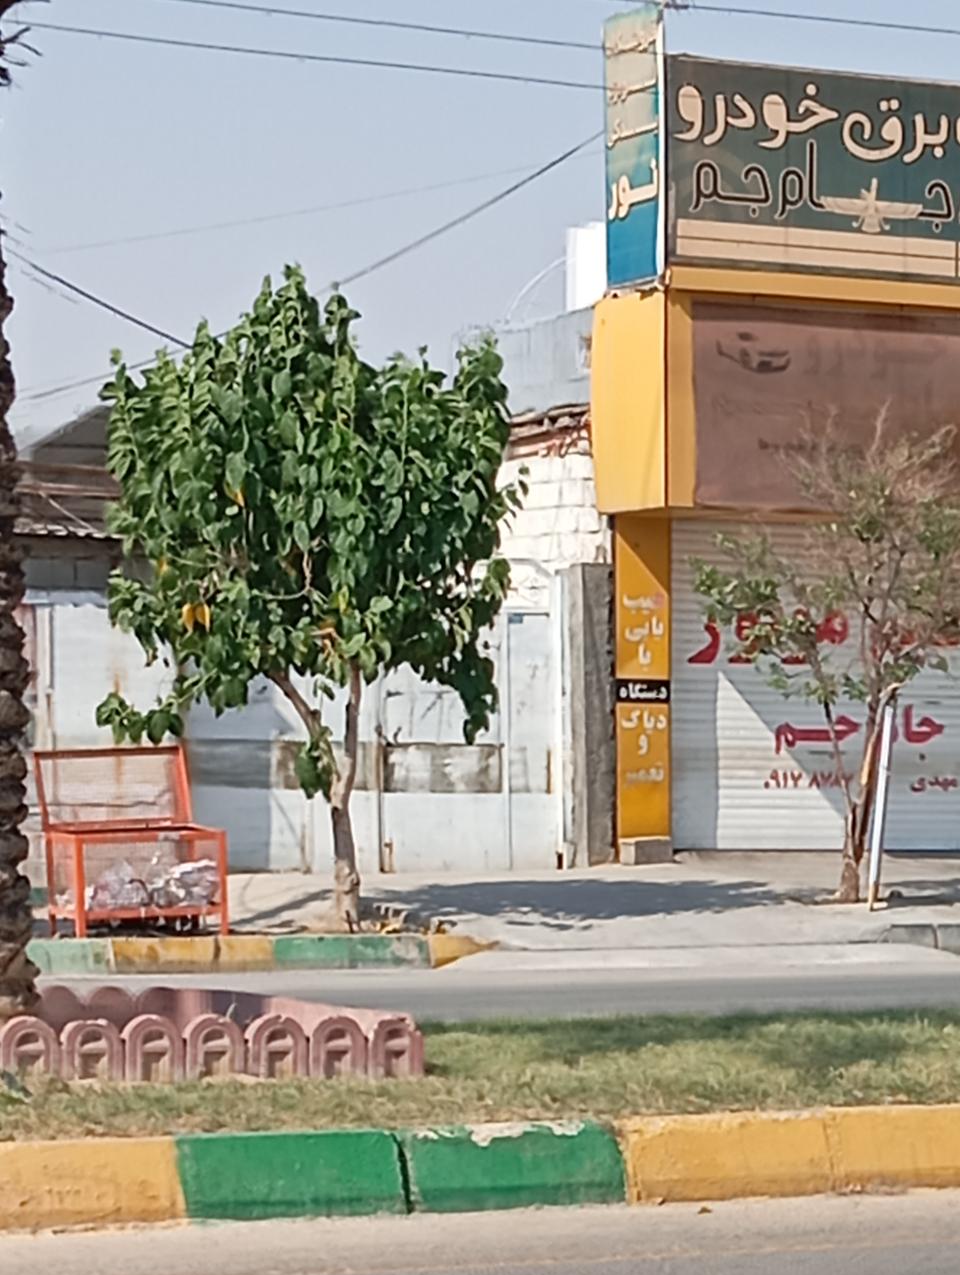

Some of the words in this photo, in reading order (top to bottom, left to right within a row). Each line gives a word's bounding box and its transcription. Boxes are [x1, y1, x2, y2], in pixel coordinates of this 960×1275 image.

[674, 82, 840, 149] خودرو
[842, 96, 949, 165] برق
[689, 159, 772, 218] جم
[619, 682, 668, 700] دستگاه
[909, 774, 958, 793] مهدی
